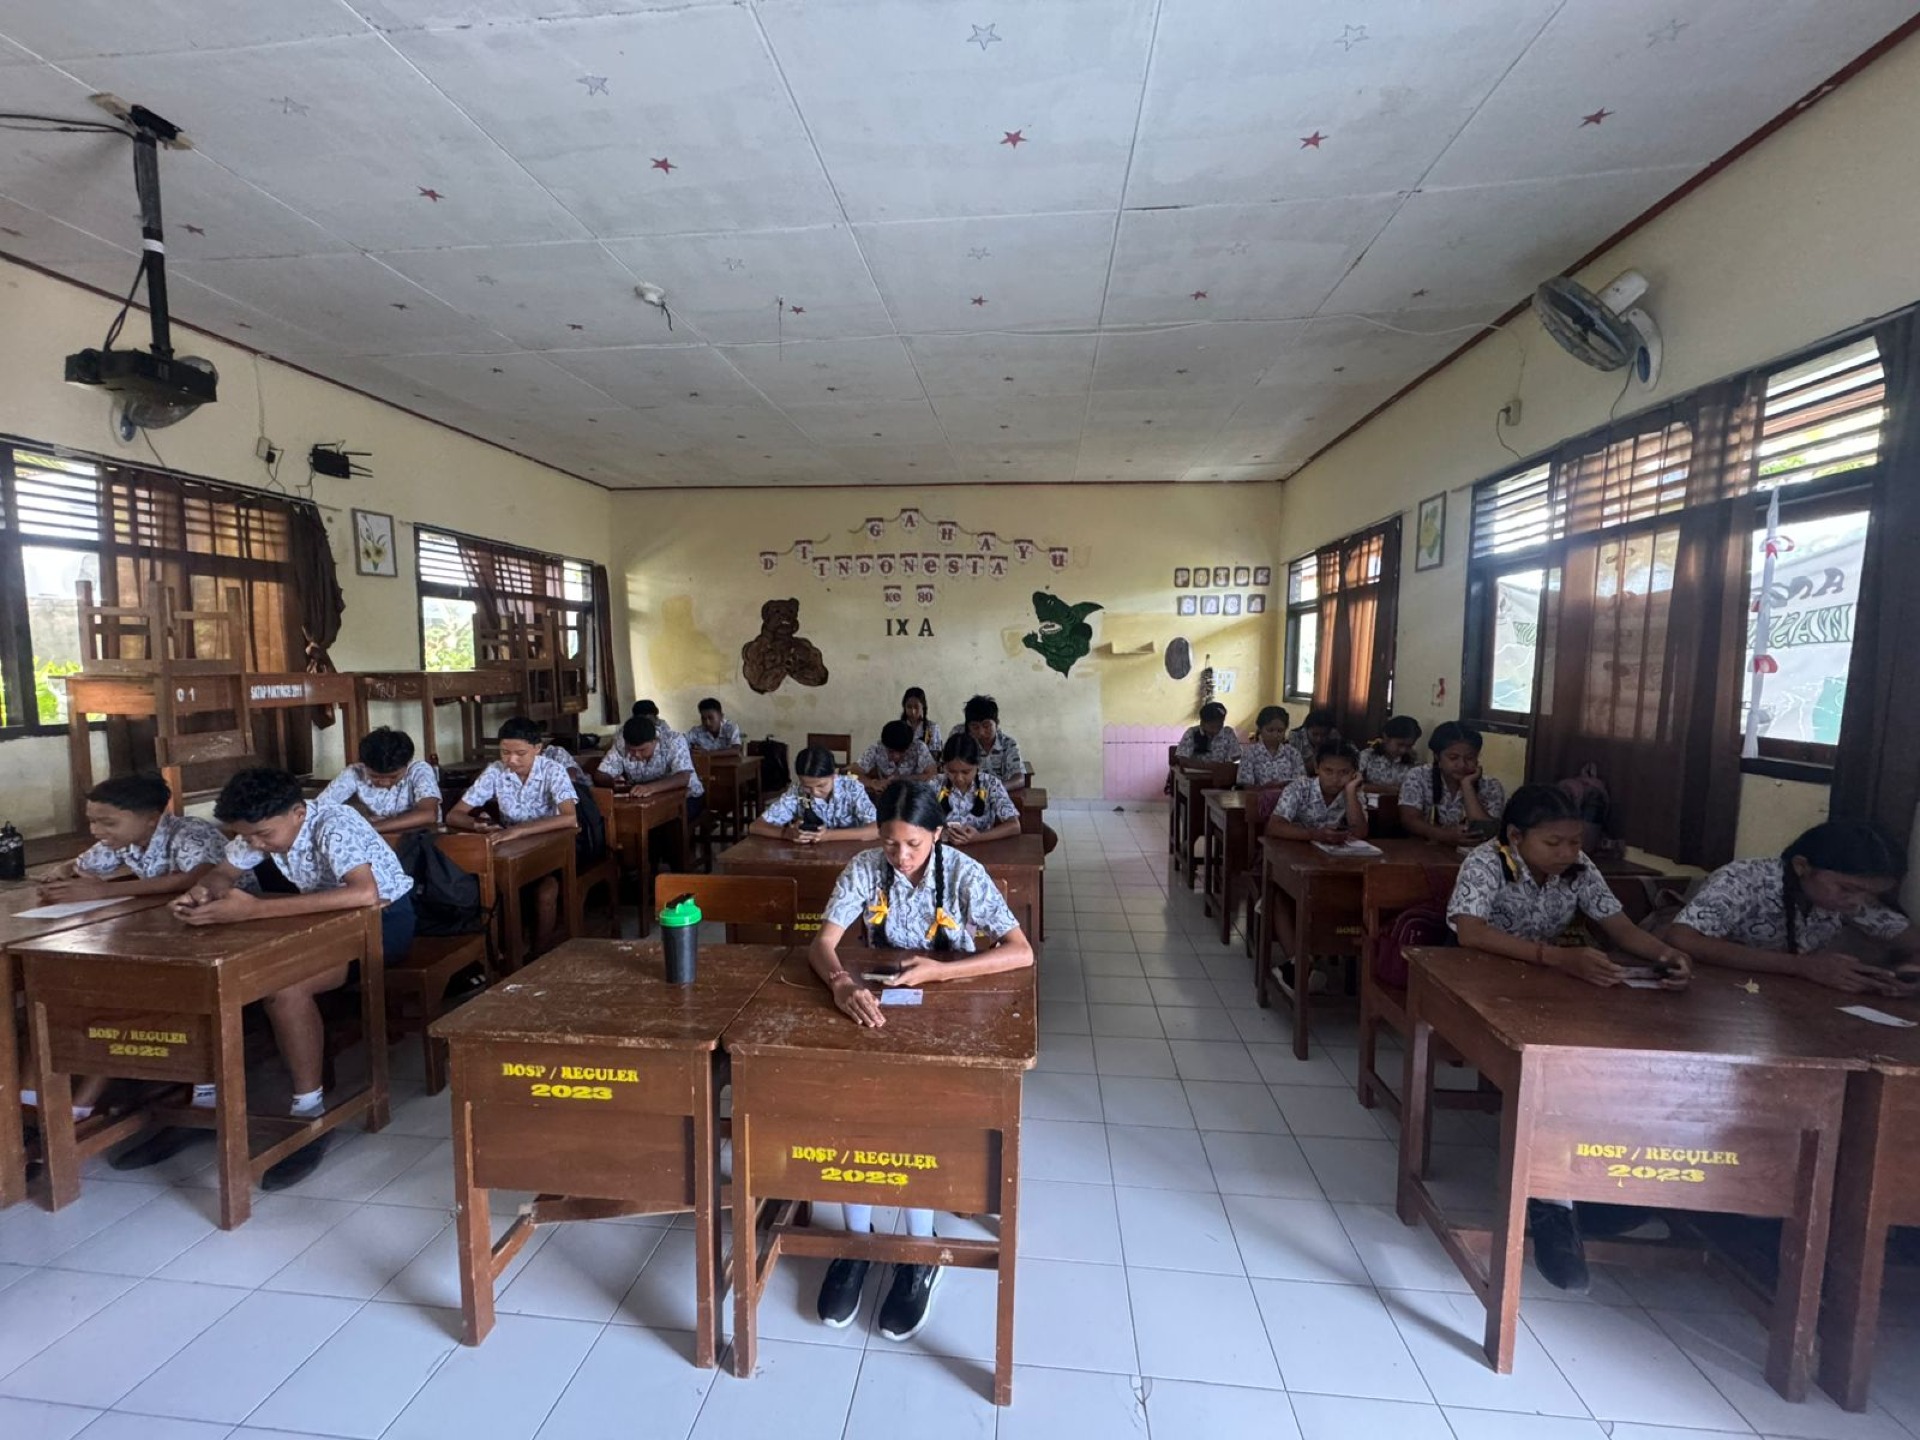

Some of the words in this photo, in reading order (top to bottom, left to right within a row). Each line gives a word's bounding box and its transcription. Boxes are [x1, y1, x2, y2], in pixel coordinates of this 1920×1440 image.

[88, 1027, 120, 1039] BOSP
[130, 1030, 188, 1044] REGULER
[109, 1043, 169, 1057] 2023
[502, 1063, 546, 1078] BOSP
[561, 1066, 639, 1082] REGULER
[530, 1083, 613, 1100] 2023
[791, 1146, 837, 1163] BOSP
[853, 1150, 939, 1170] REGULER
[1576, 1143, 1628, 1159] BOSP
[1645, 1147, 1740, 1165] REGULER
[821, 1167, 909, 1186] 2023
[1607, 1164, 1706, 1182] 2023
